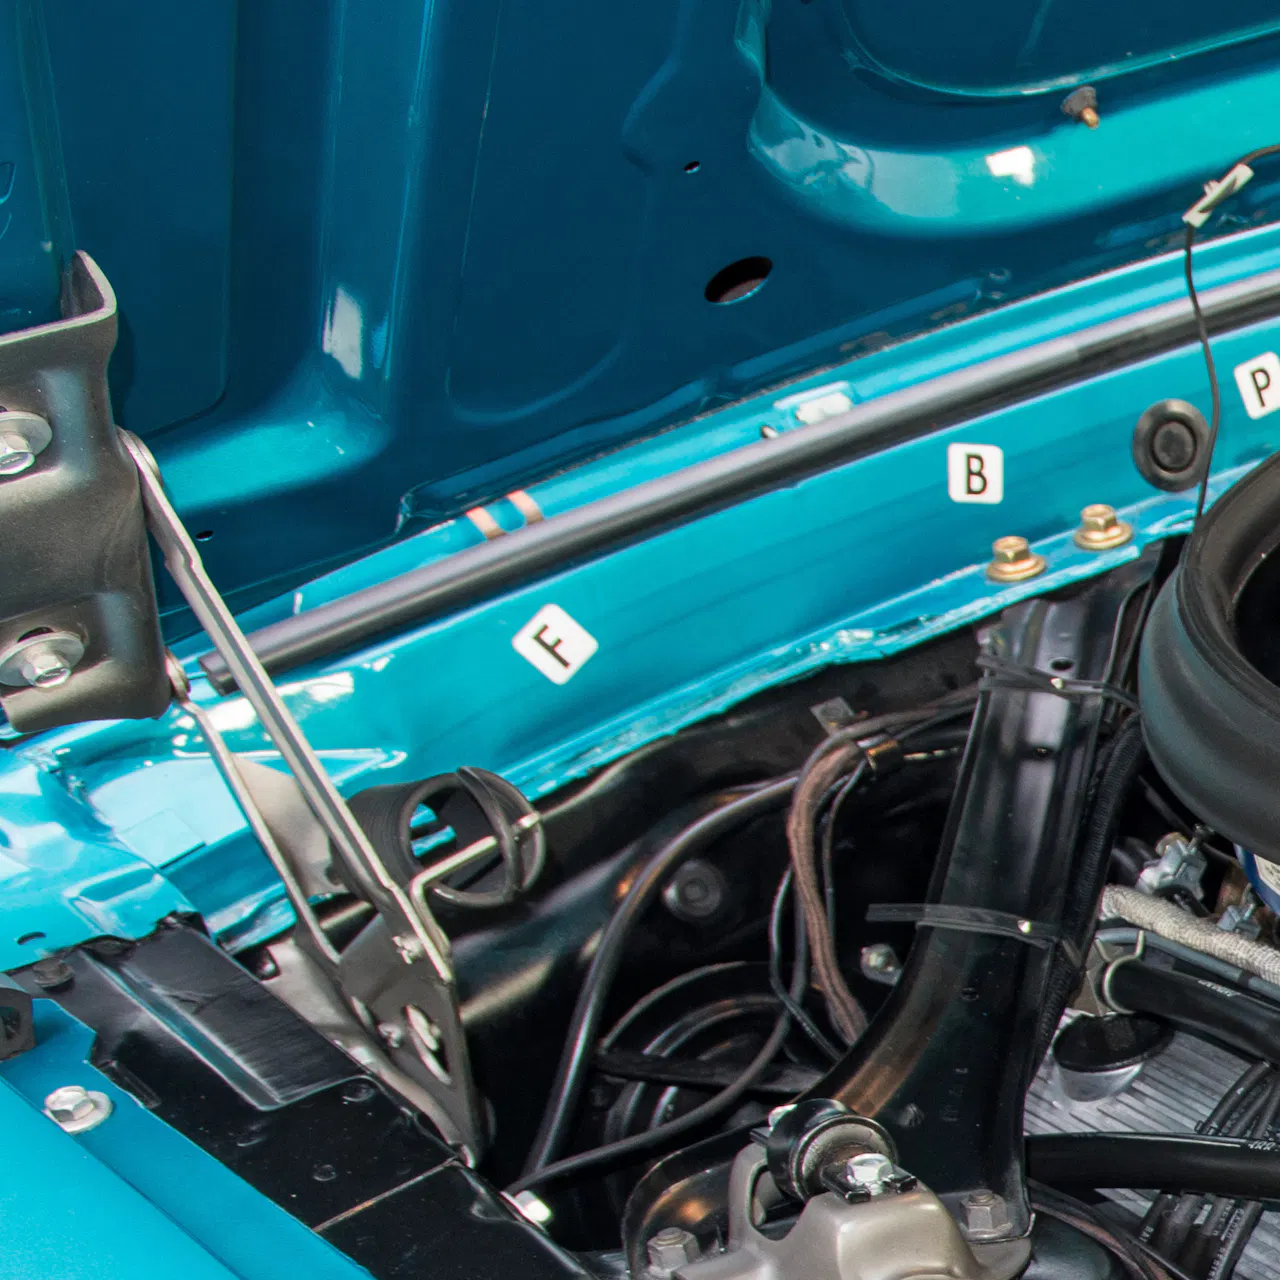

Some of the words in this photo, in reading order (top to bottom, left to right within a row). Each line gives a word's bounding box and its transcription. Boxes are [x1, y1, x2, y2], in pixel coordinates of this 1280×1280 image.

[1250, 367, 1271, 408] P
[965, 453, 987, 495] B
[532, 624, 570, 669] F
